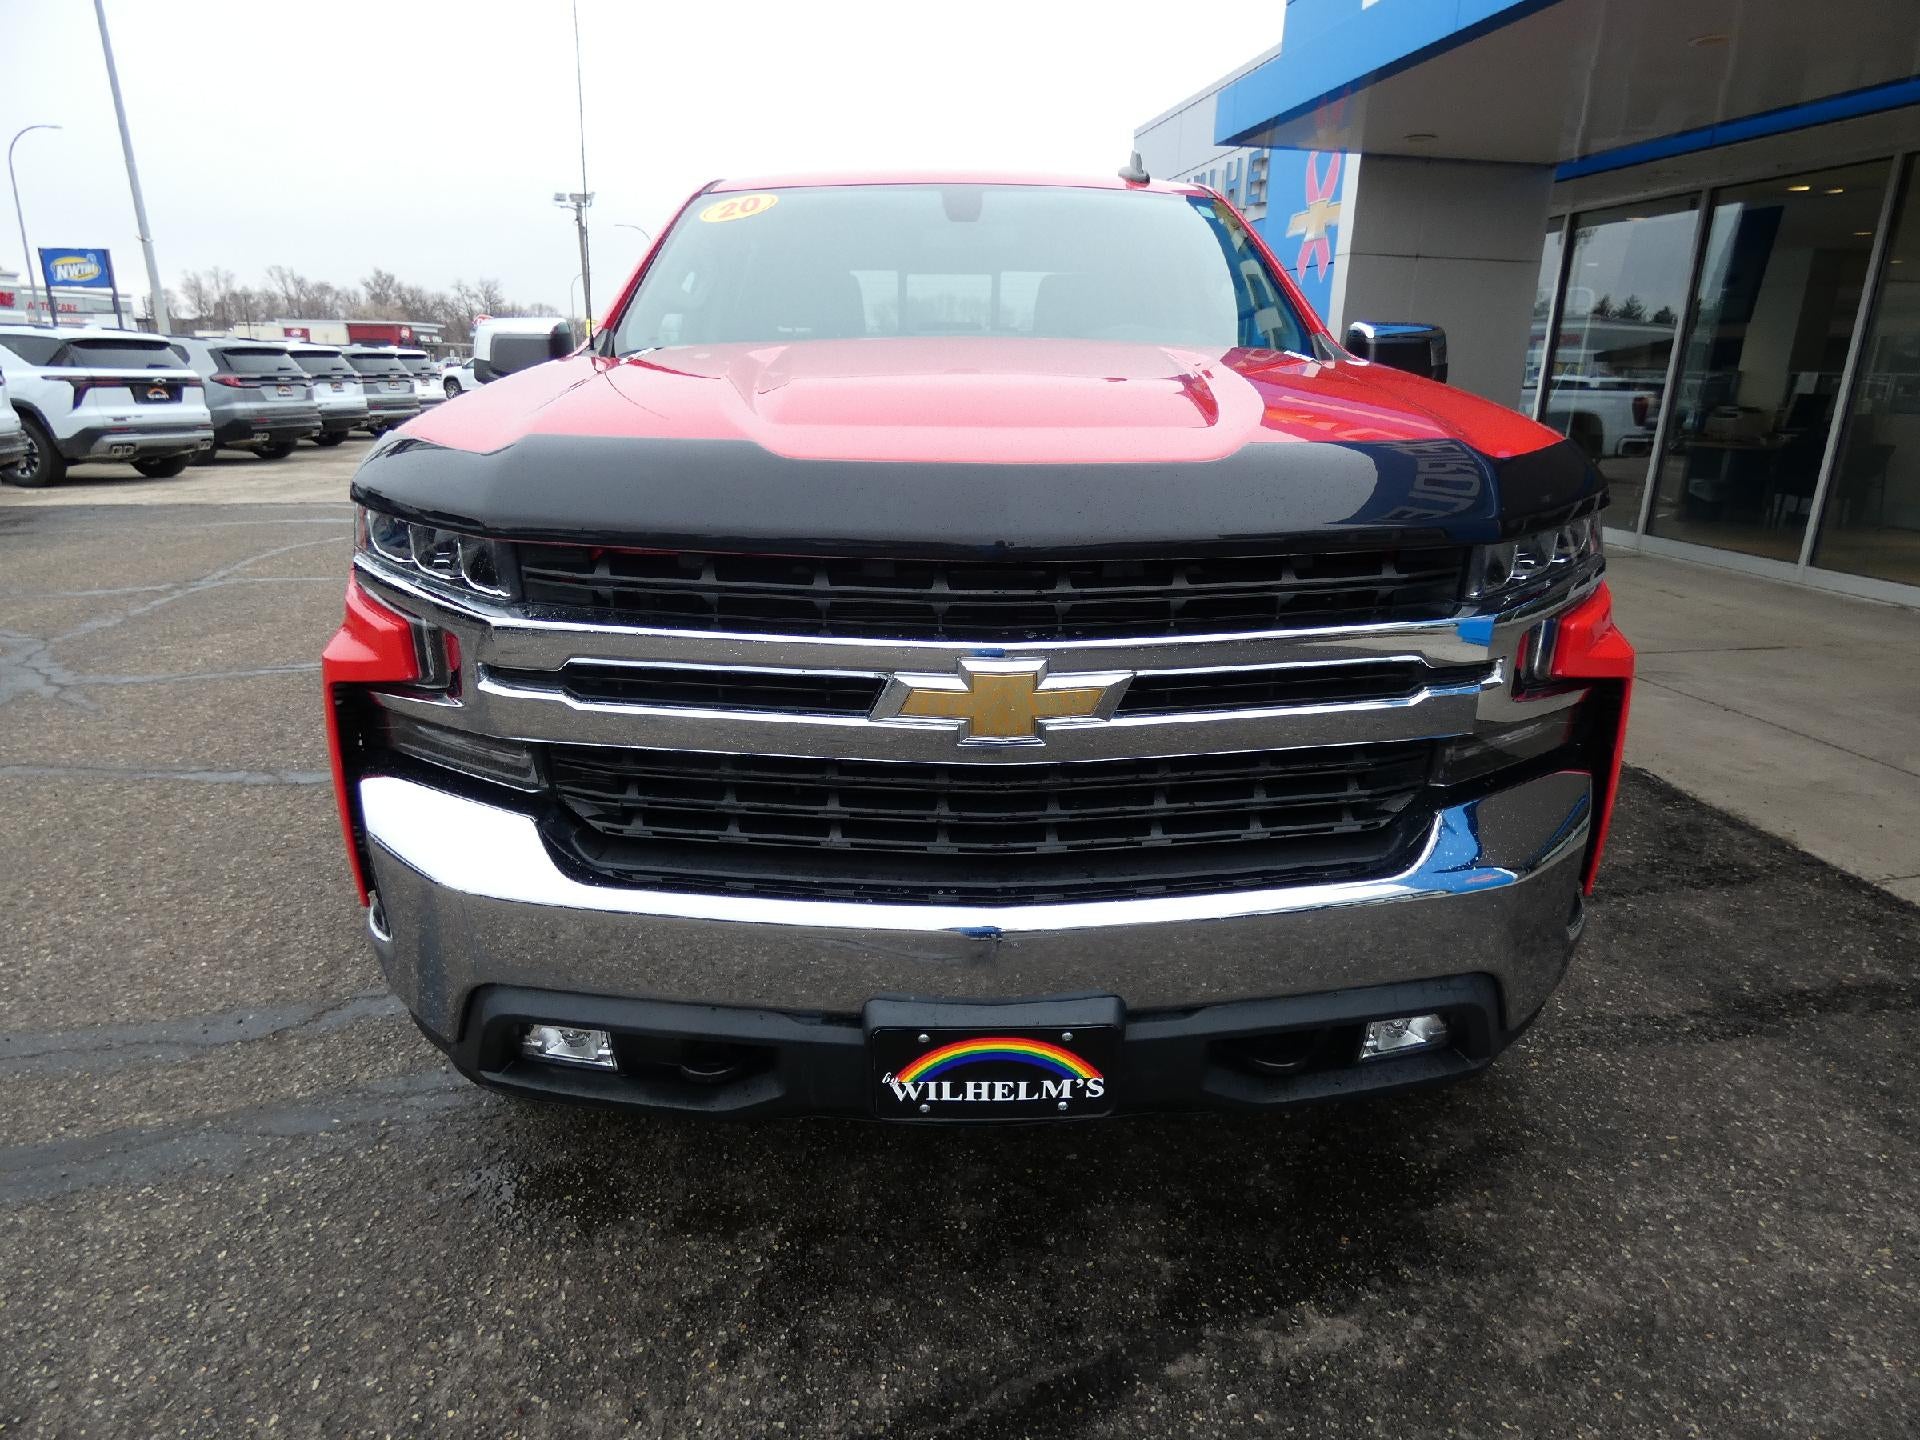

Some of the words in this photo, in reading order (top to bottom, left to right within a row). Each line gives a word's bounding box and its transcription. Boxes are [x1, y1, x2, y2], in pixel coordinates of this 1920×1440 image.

[718, 197, 761, 219] 20
[27, 301, 51, 312] ATO
[881, 1071, 901, 1087] by
[891, 1077, 1106, 1102] WILHELM'S
